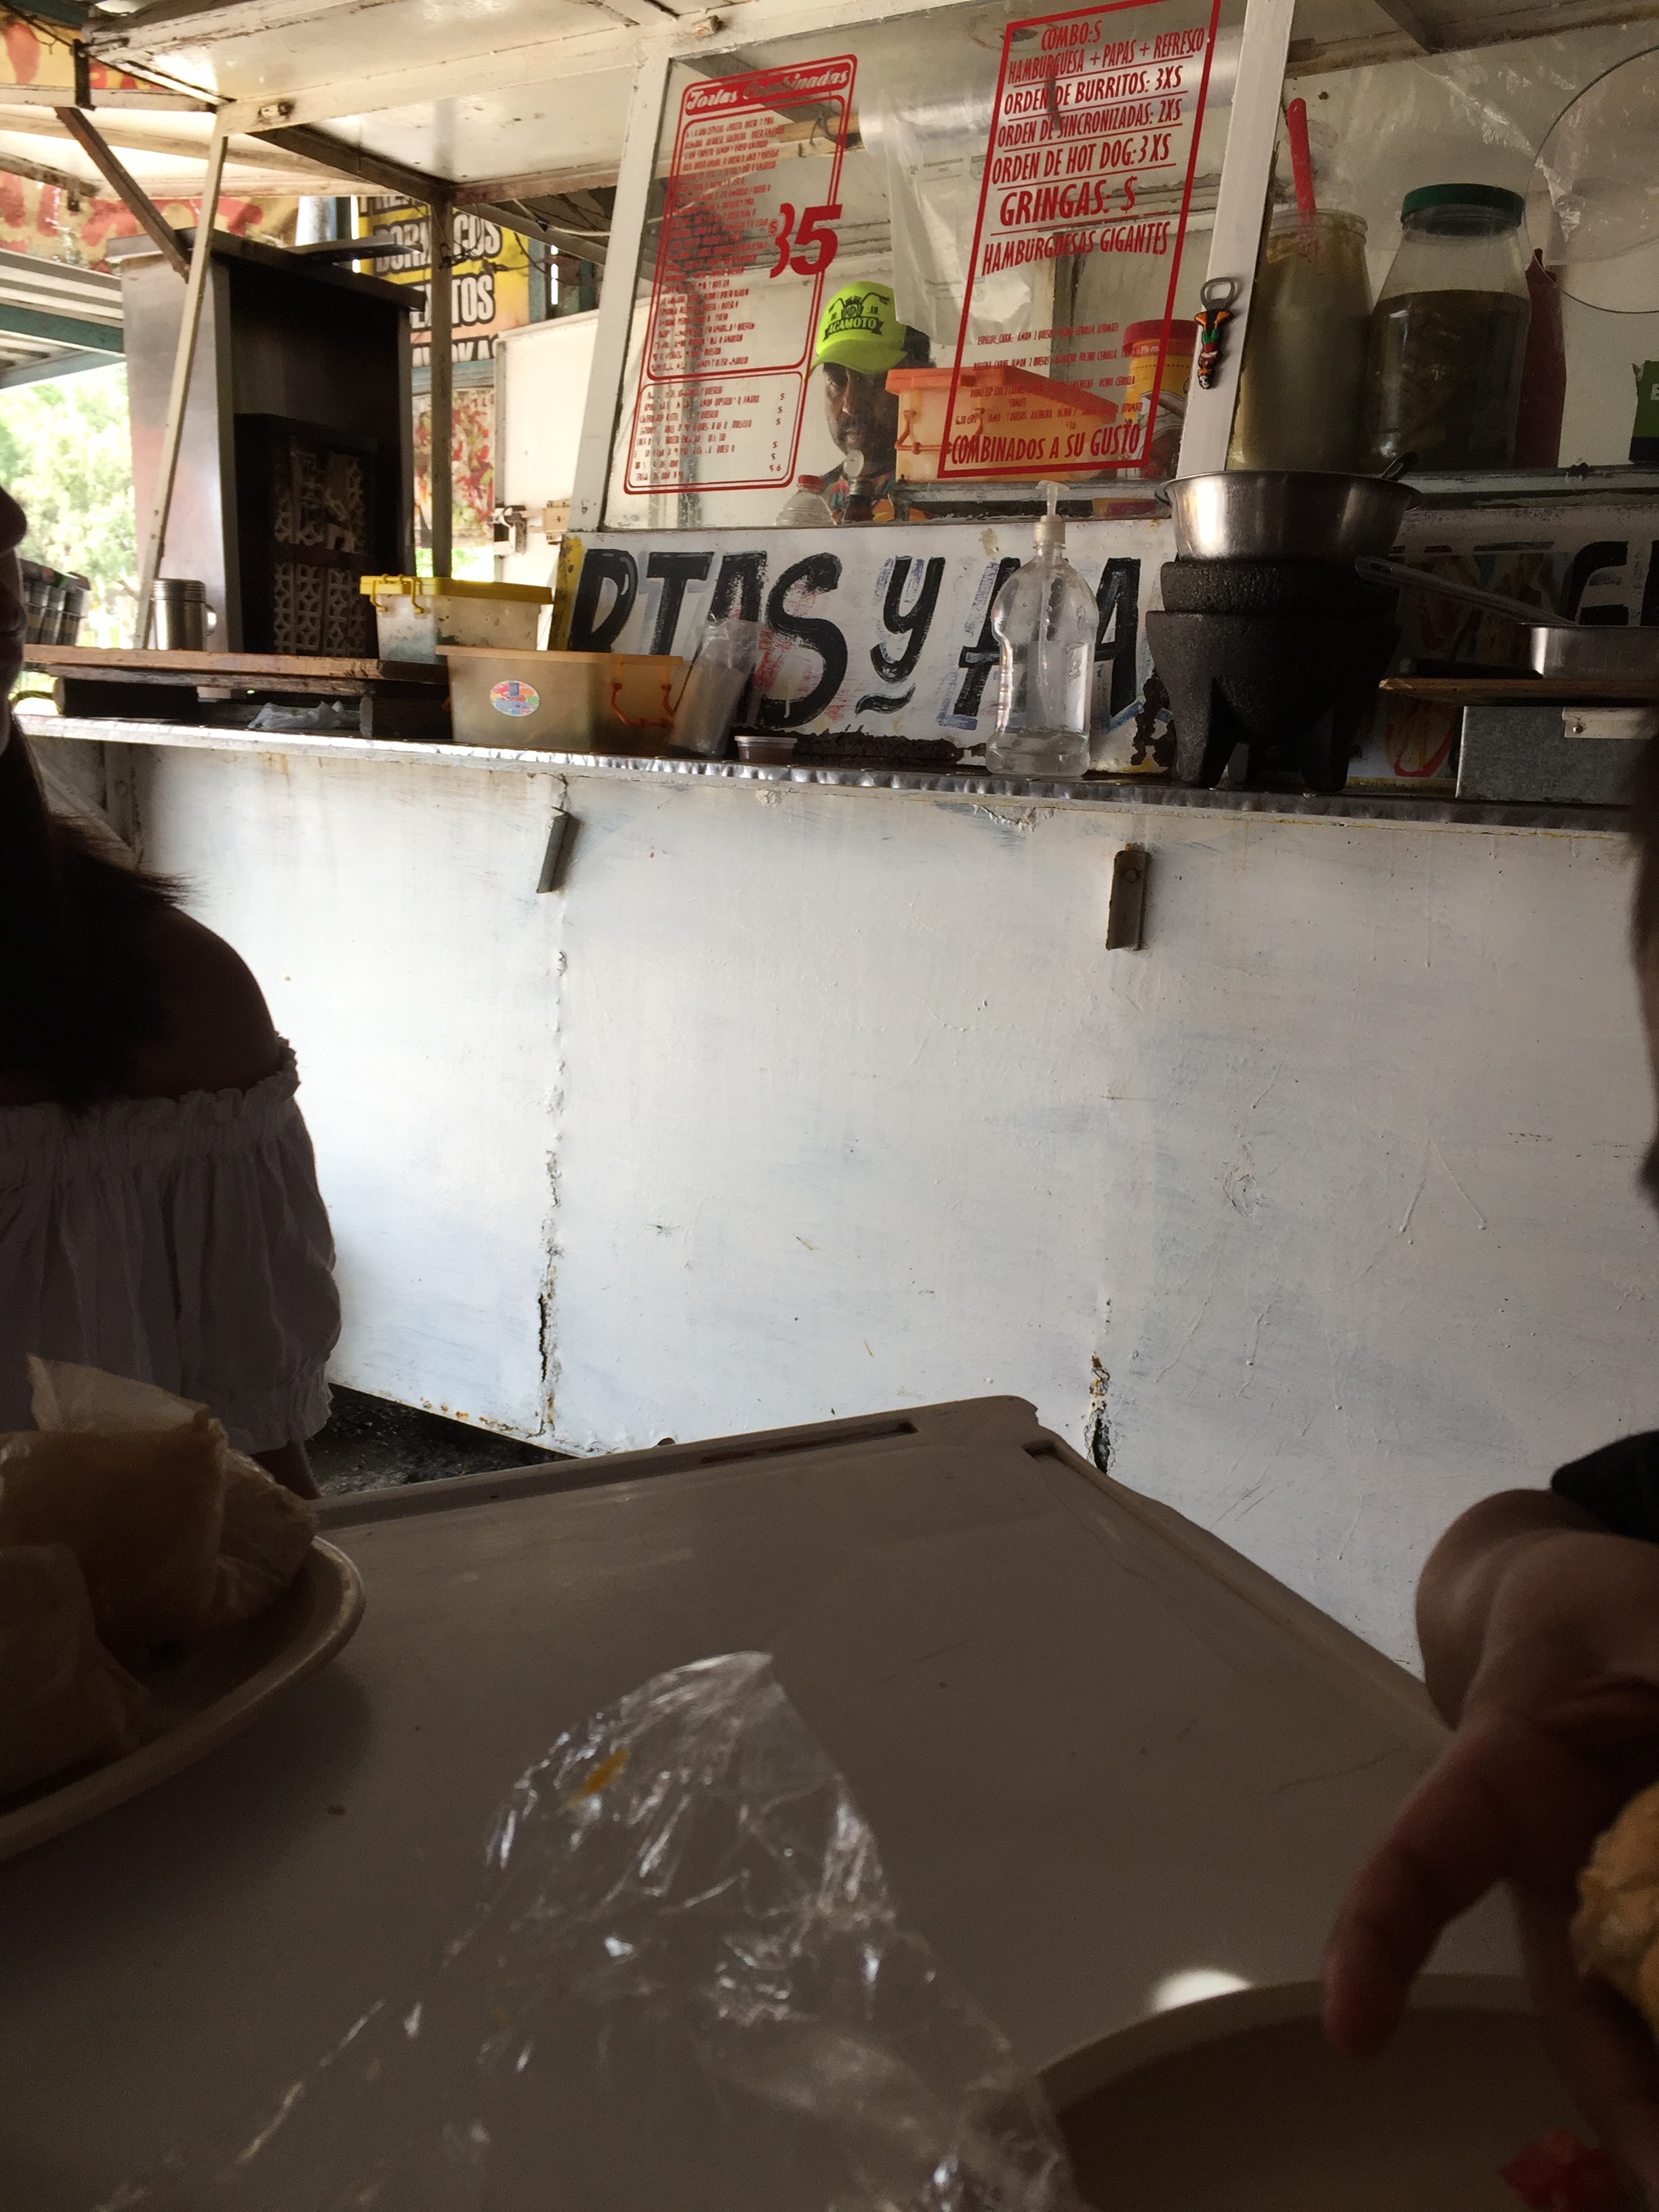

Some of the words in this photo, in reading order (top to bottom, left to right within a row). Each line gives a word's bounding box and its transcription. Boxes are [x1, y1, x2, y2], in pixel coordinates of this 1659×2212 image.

[1008, 49, 1084, 83] HAMBURGUESA
[1103, 40, 1135, 66] PAPAS
[1153, 28, 1206, 59] REFRESCO
[1004, 87, 1049, 115] ORDEN
[1054, 85, 1071, 105] DE
[1075, 73, 1151, 103] BURRITOS:
[998, 123, 1036, 147] ORDEN
[1040, 118, 1055, 140] DE
[1059, 103, 1154, 138] SINCRONIZADAS:
[992, 154, 1039, 184] ORDEN
[1044, 149, 1063, 178] DE
[1066, 144, 1096, 173] HOT
[1000, 180, 1111, 226] GRINGAS:
[1120, 176, 1138, 213] $
[982, 230, 1094, 275] HAMBURGUESAS
[1100, 222, 1170, 255] GIGANTES
[951, 434, 1044, 465] COMBINADOS
[1050, 437, 1059, 459] A
[1065, 432, 1086, 457] SU
[1090, 424, 1141, 456] GUSTO
